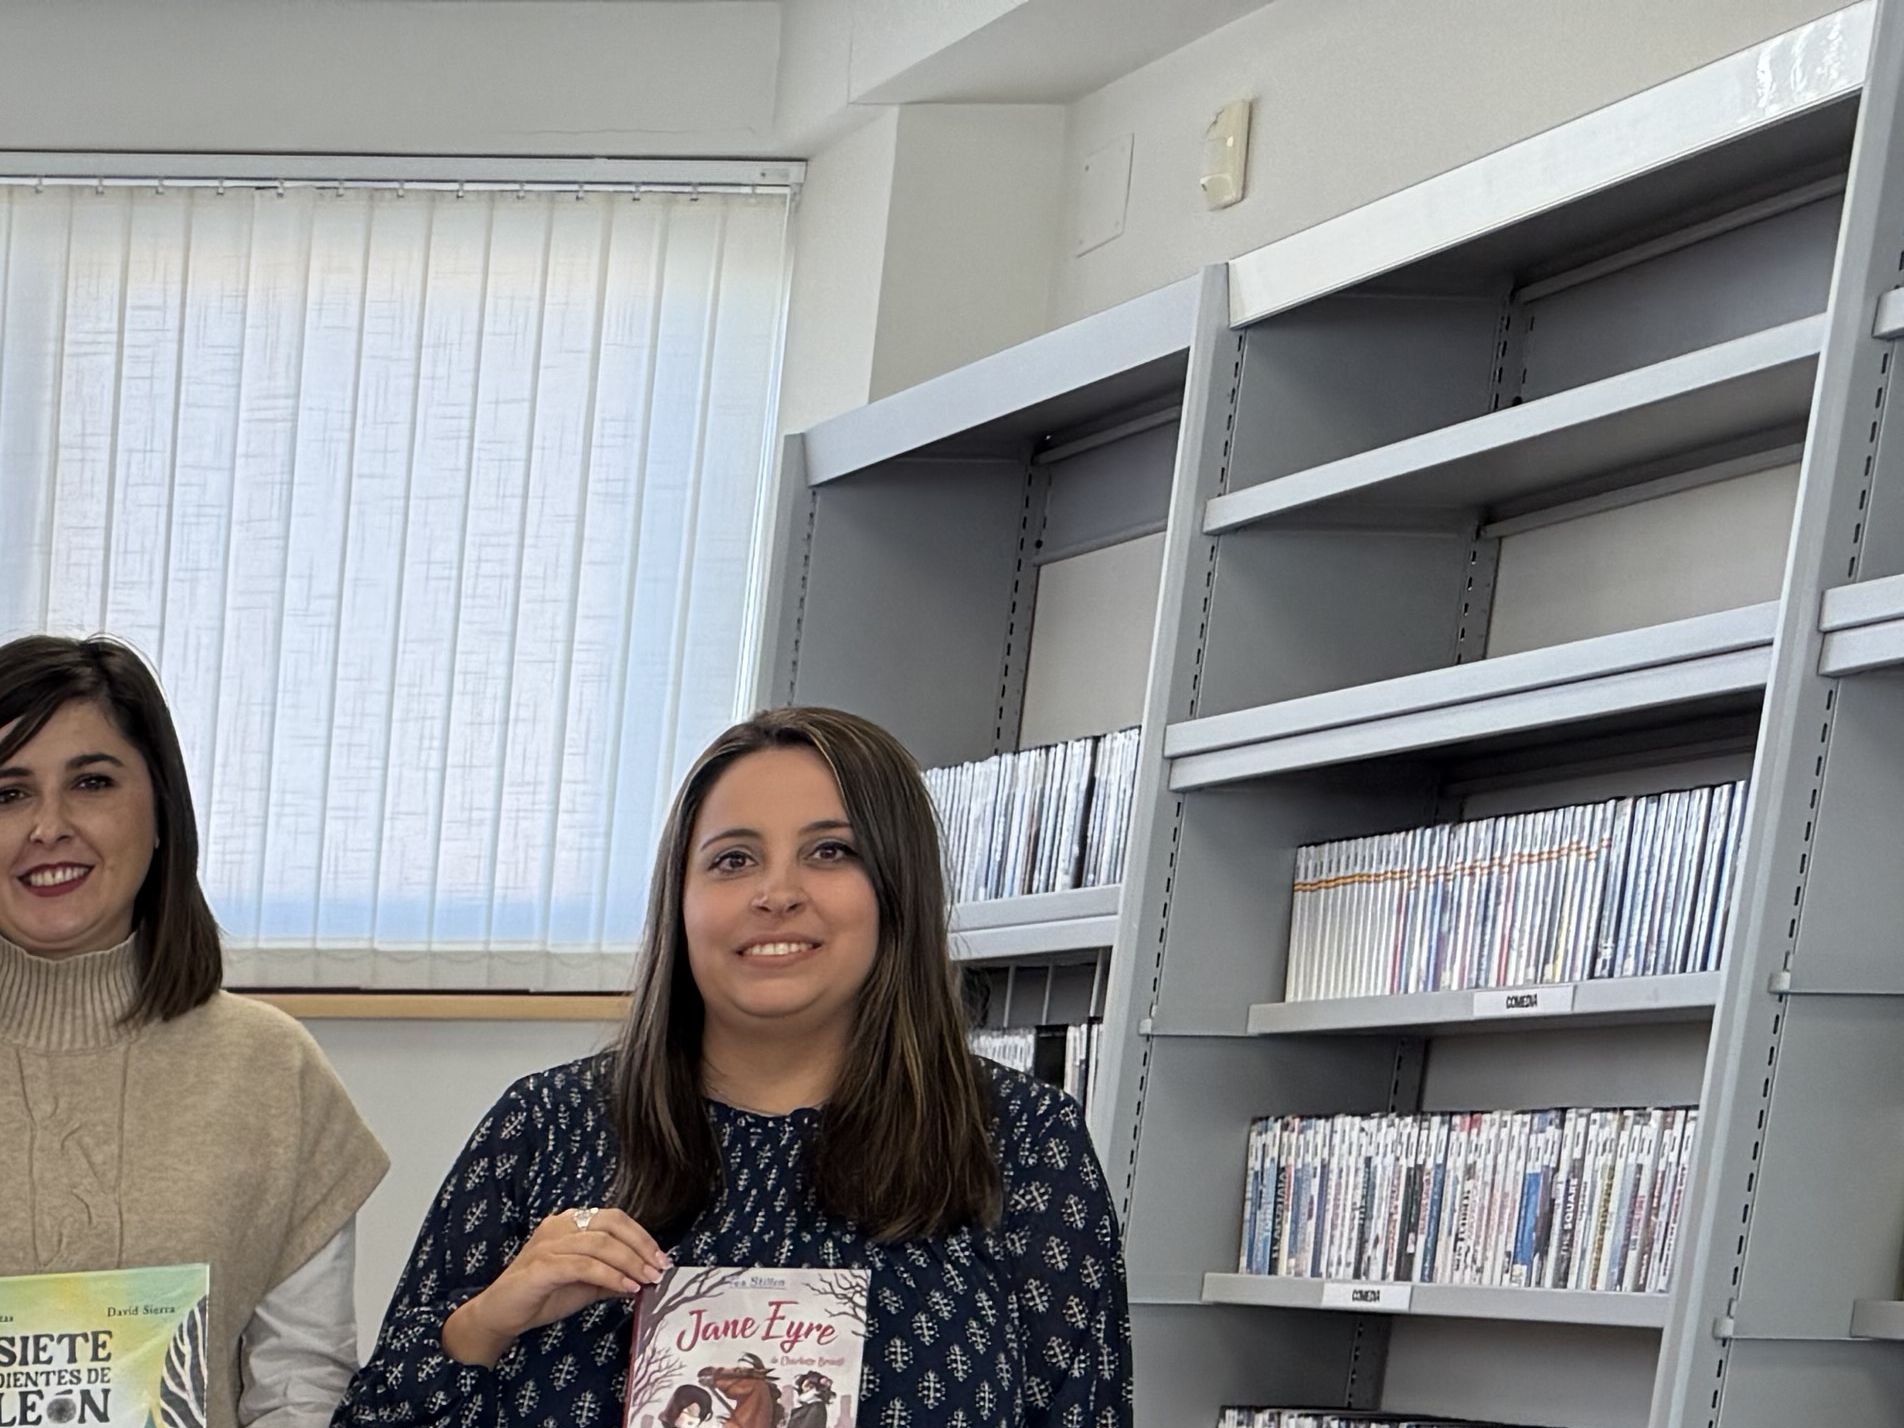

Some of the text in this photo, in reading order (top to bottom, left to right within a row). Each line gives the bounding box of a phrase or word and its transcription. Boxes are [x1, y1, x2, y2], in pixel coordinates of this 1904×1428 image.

[1505, 993, 1538, 1010] COMEDIA
[1564, 1177, 1580, 1226] SQUARE
[107, 1304, 176, 1317] David Sierra
[676, 1300, 839, 1353] Jane Eyre
[86, 1367, 111, 1384] DE
